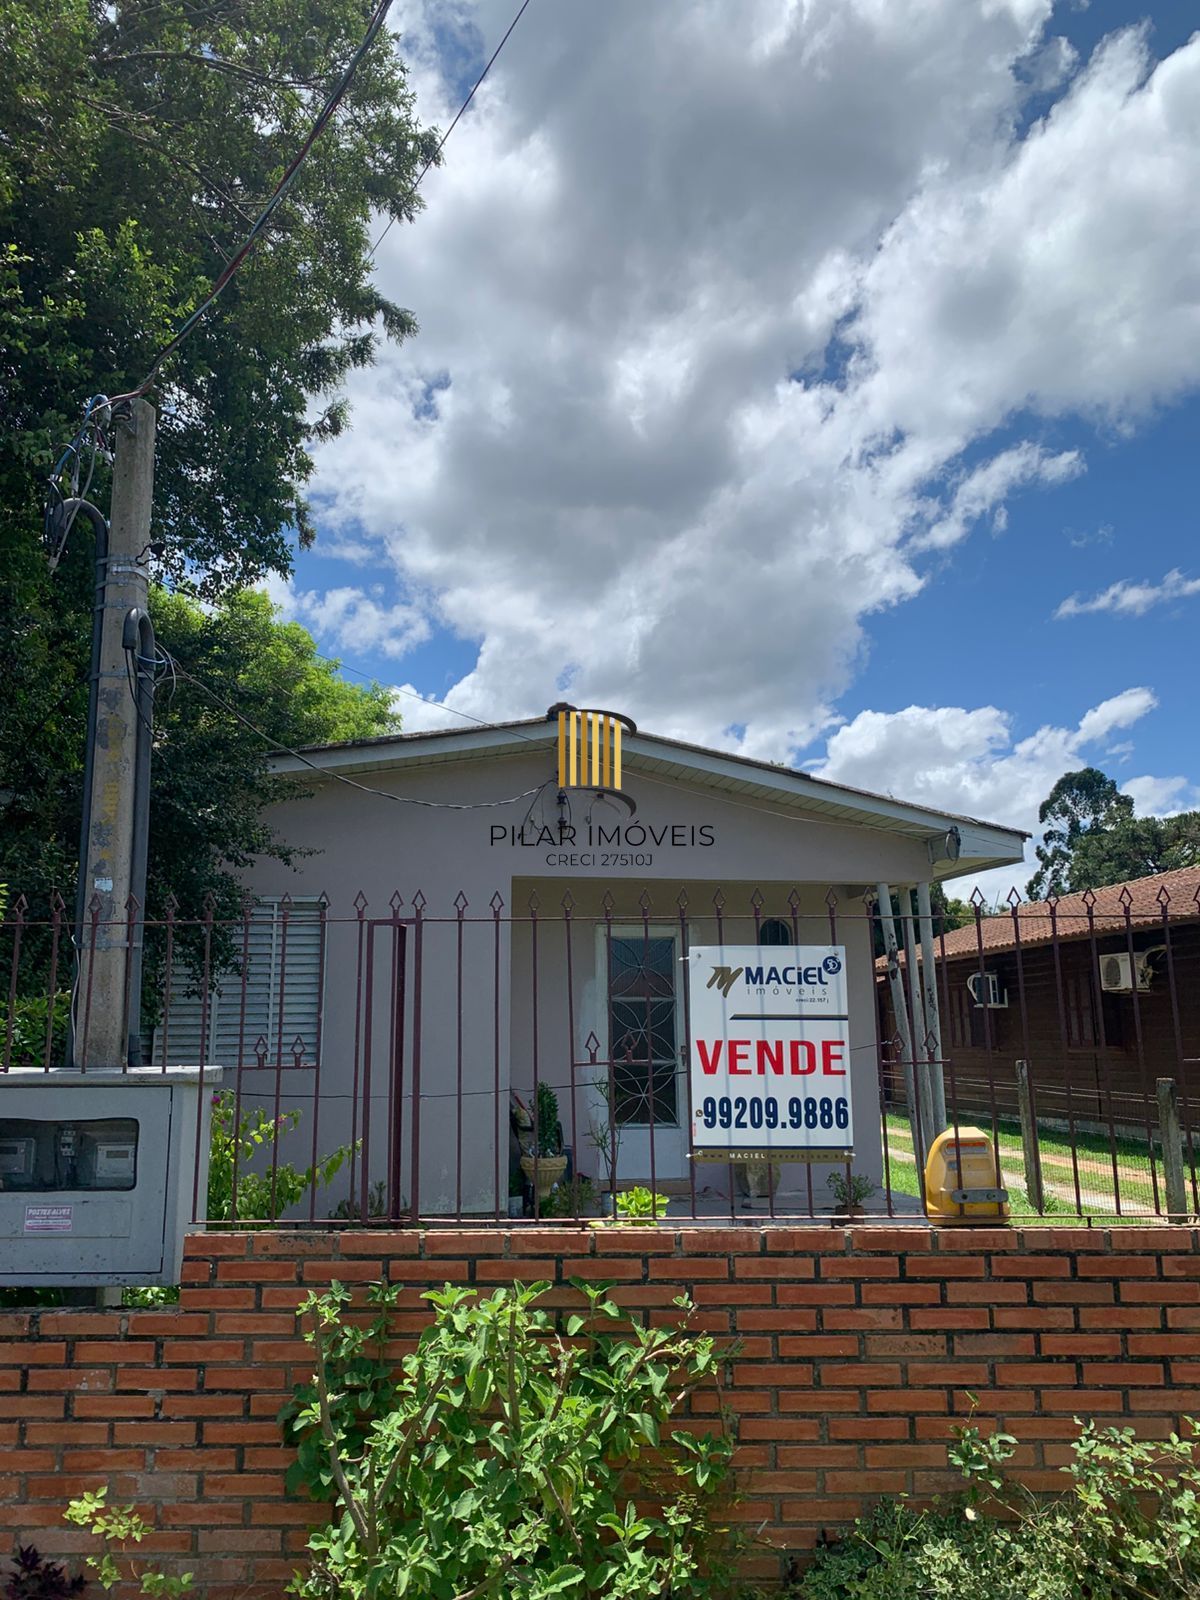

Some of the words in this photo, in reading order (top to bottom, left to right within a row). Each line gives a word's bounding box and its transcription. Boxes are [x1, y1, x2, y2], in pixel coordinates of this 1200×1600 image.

[747, 986, 827, 995] imóveis
[696, 1040, 846, 1076] VENDE
[703, 1096, 849, 1130] 99209.9886
